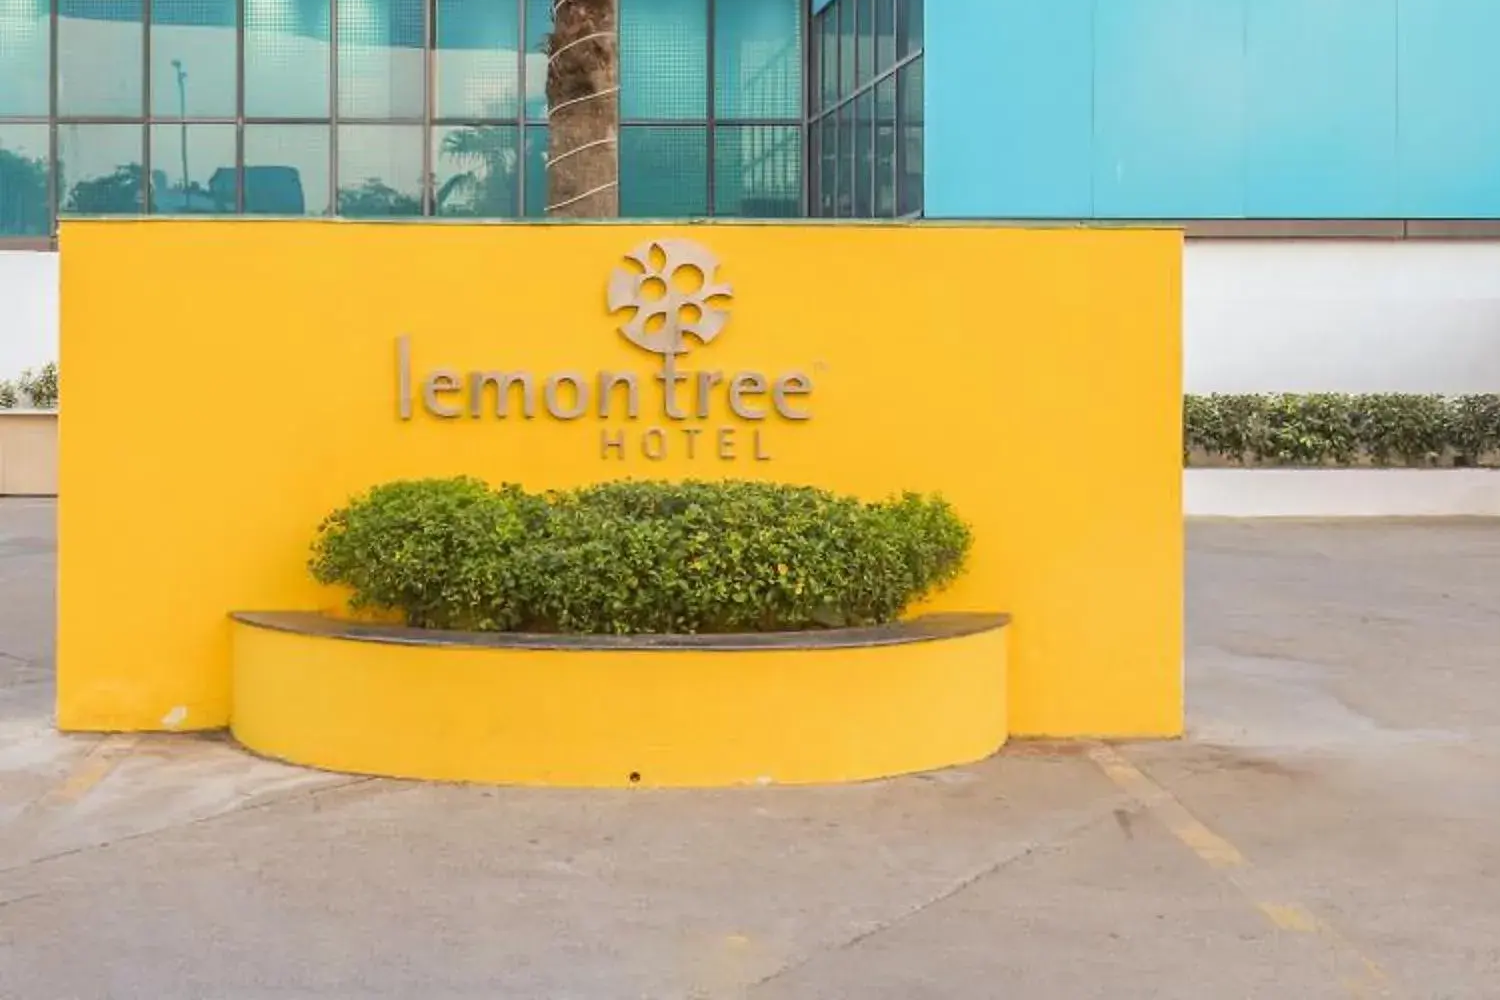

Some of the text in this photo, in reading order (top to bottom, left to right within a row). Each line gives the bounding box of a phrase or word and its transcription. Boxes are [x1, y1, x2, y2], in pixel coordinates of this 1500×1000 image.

[394, 334, 813, 420] lemon tree
[601, 427, 773, 460] HOTEL
